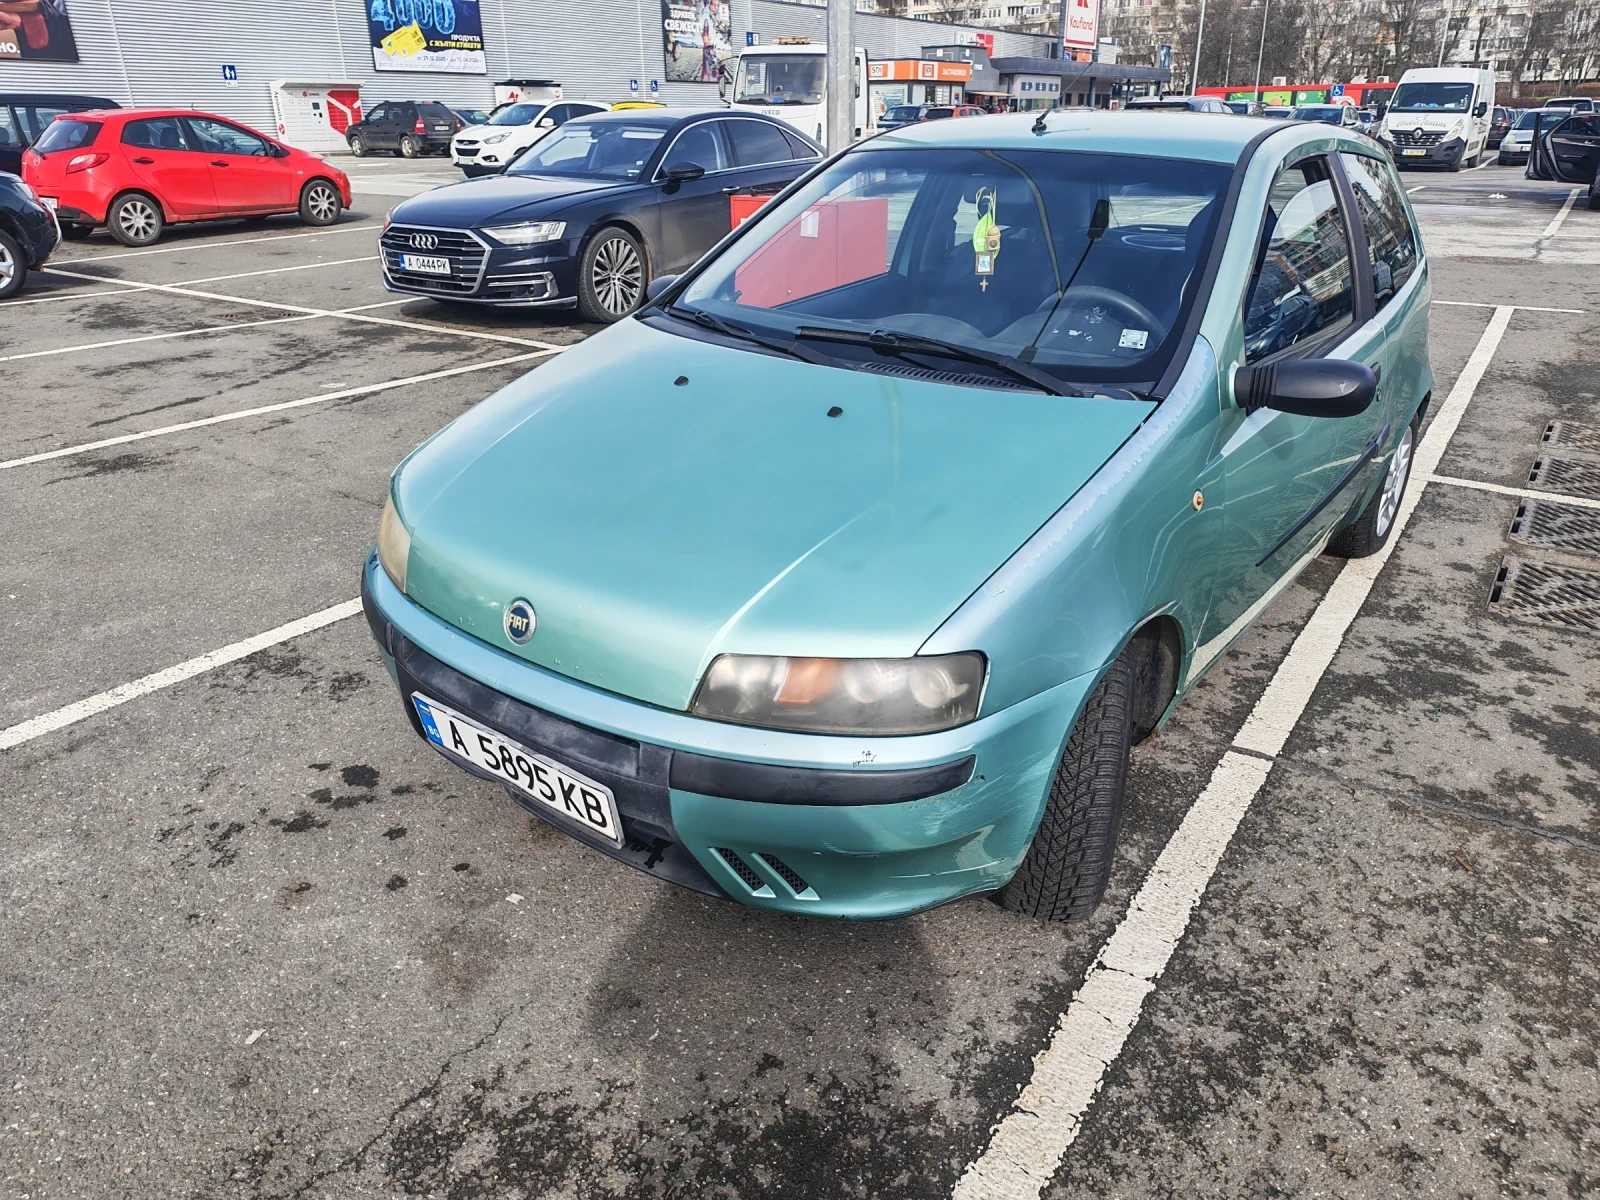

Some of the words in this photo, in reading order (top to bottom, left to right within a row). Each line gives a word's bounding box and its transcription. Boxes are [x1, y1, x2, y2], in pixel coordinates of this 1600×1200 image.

[370, 0, 456, 35] 4000
[1070, 15, 1094, 31] Kaufland
[451, 34, 480, 42] ПРОДУКТА
[871, 66, 882, 75] SDI
[408, 257, 414, 269] A
[507, 612, 528, 632] FIAT
[427, 724, 441, 739] BG
[449, 720, 470, 757] A
